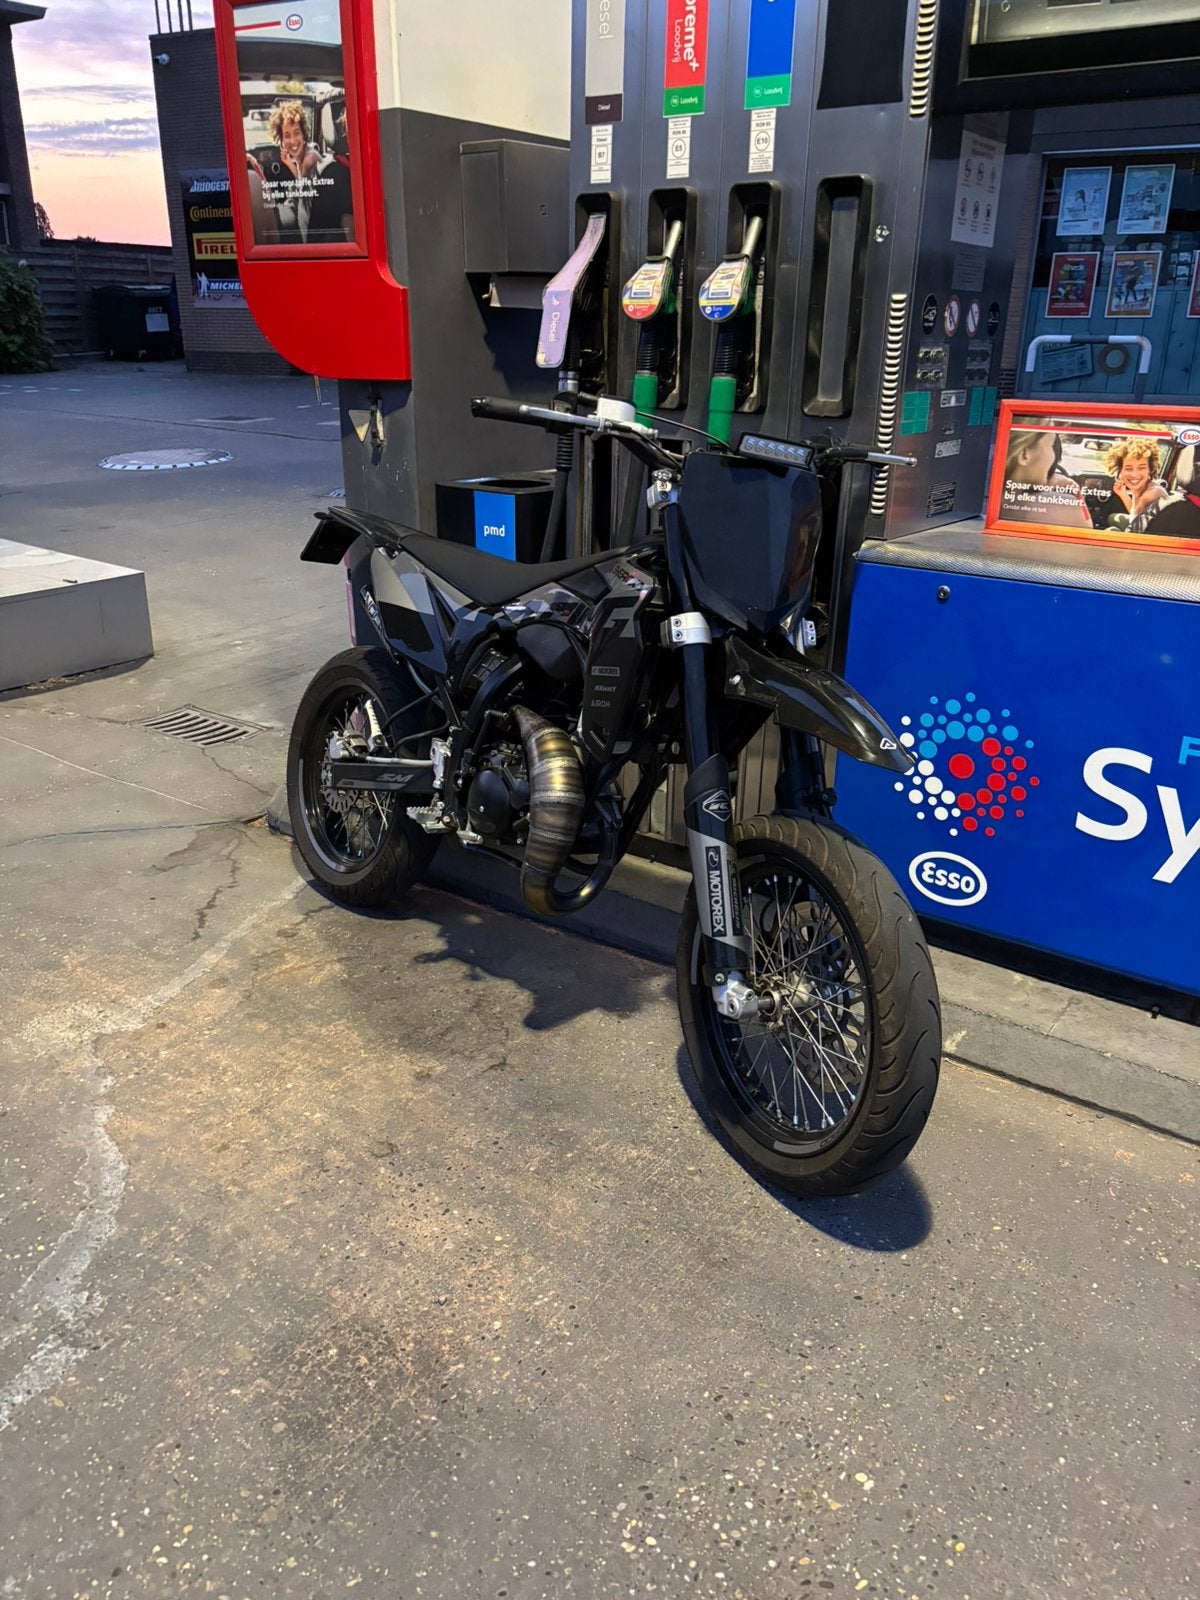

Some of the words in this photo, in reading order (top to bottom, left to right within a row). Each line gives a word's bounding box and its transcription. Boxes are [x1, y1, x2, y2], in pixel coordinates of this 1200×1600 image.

[671, 18, 683, 63] Loodvrij
[756, 137, 768, 145] E10
[261, 179, 279, 190] Spaar
[312, 177, 335, 186] Extras
[262, 190, 271, 201] bij
[271, 190, 285, 199] elke
[285, 189, 320, 198] tankbeurt.
[547, 311, 560, 343] Diesel
[1183, 432, 1200, 441] Esso
[1005, 479, 1032, 491] Spaar
[1033, 483, 1054, 492] voor
[1055, 484, 1080, 495] toffe
[1081, 486, 1112, 498] Extras
[1004, 490, 1017, 503] bij
[1017, 492, 1037, 502] elke
[1038, 494, 1086, 507] tankbeurt.
[483, 525, 506, 537] pmd
[1075, 747, 1200, 884] Sy
[921, 861, 976, 895] Esso
[708, 870, 725, 933] MOTOREX
